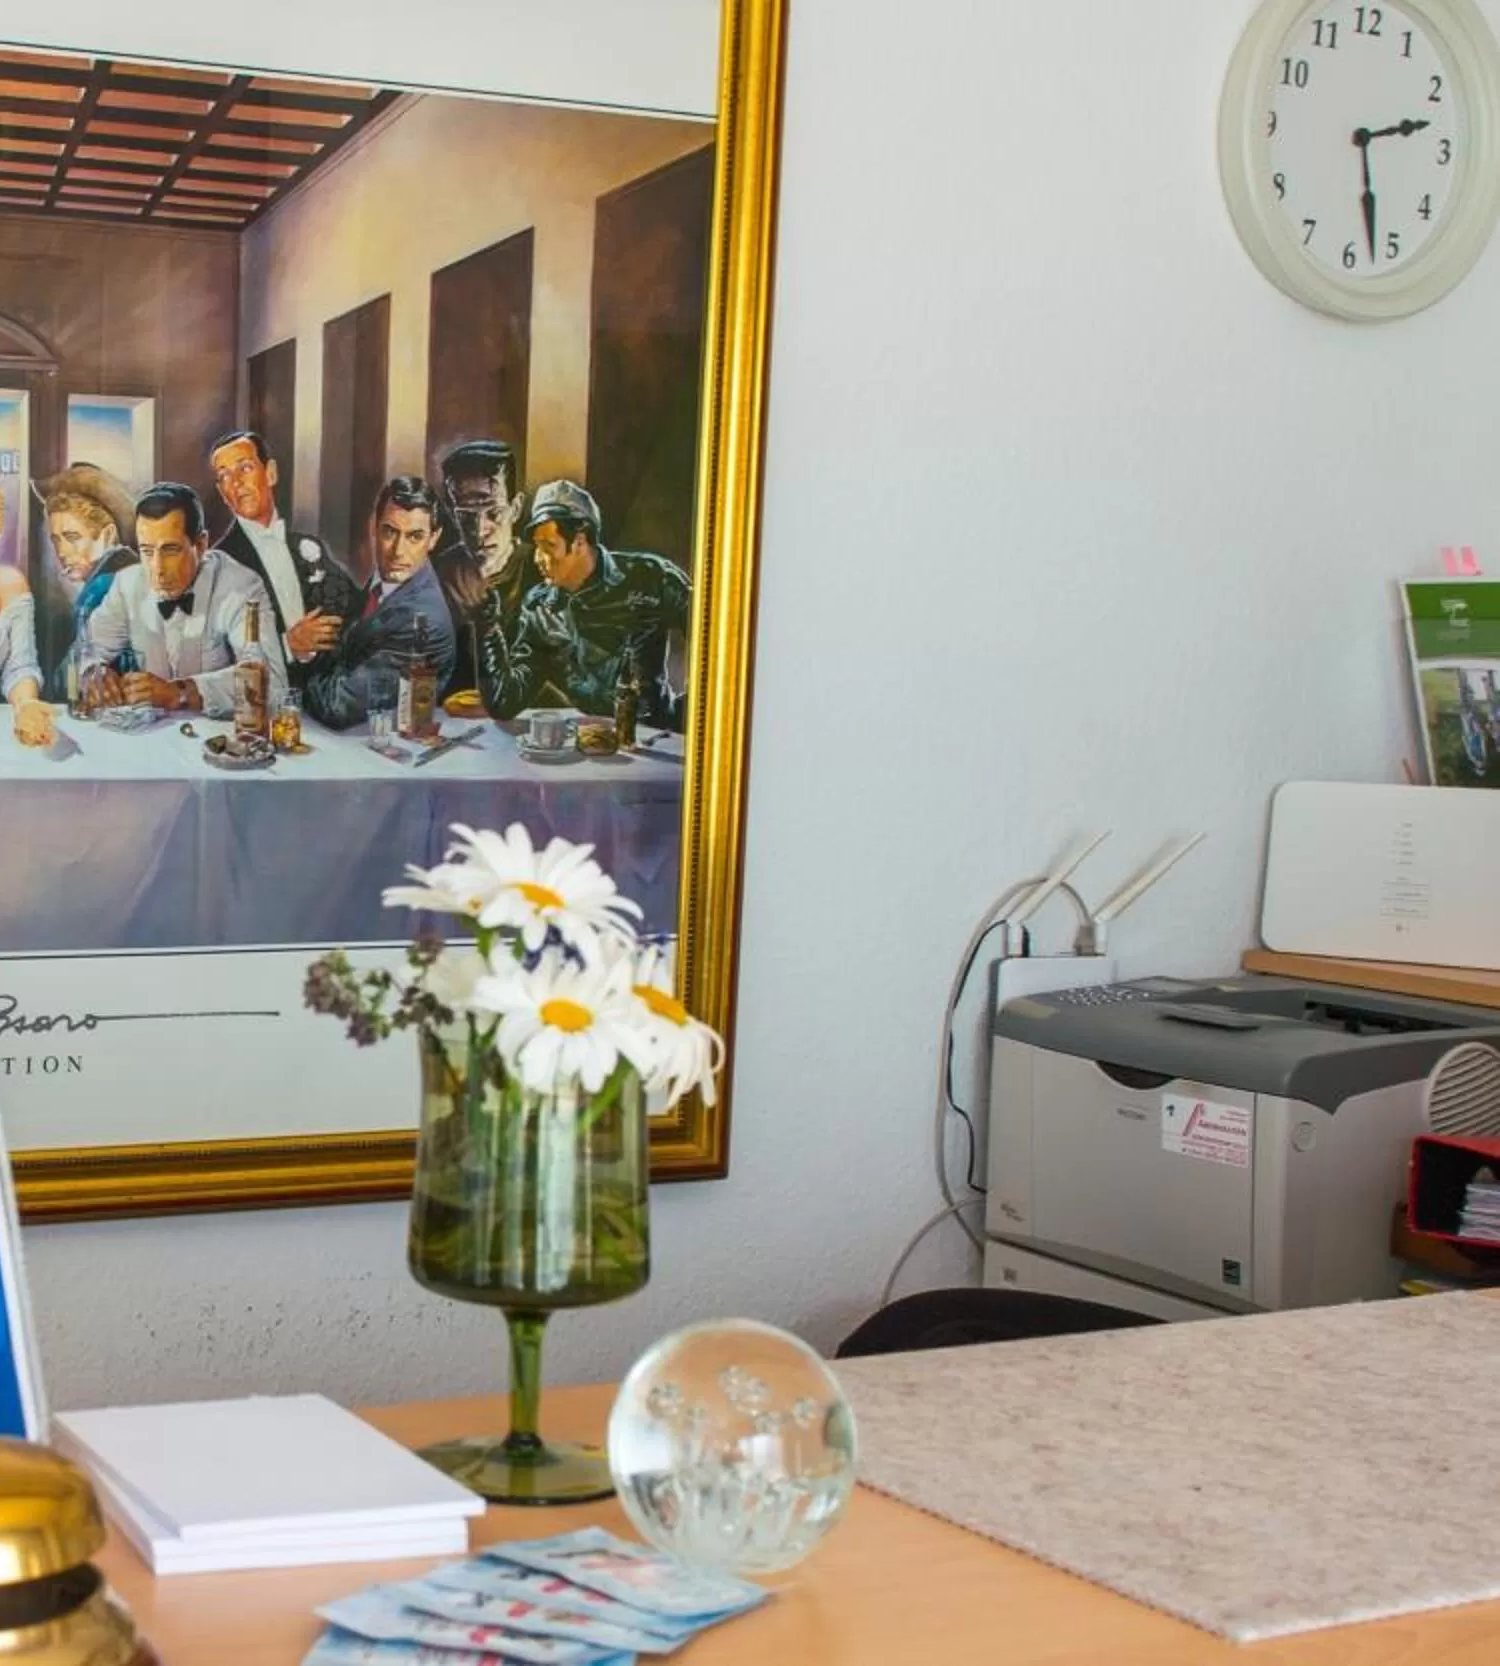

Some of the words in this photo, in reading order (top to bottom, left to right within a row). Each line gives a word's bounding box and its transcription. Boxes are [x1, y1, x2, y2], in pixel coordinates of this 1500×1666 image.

[1312, 19, 1338, 50] 11
[1353, 7, 1383, 37] 12
[1401, 31, 1413, 58] 1
[1280, 57, 1309, 88] 10
[1428, 75, 1442, 103] 2
[1436, 139, 1451, 166] 3
[1273, 173, 1286, 201] 8
[1417, 194, 1432, 221] 4
[1302, 219, 1317, 246] 7
[1342, 241, 1356, 269] 6
[1386, 233, 1400, 260] 5
[0, 1055, 83, 1075] TION
